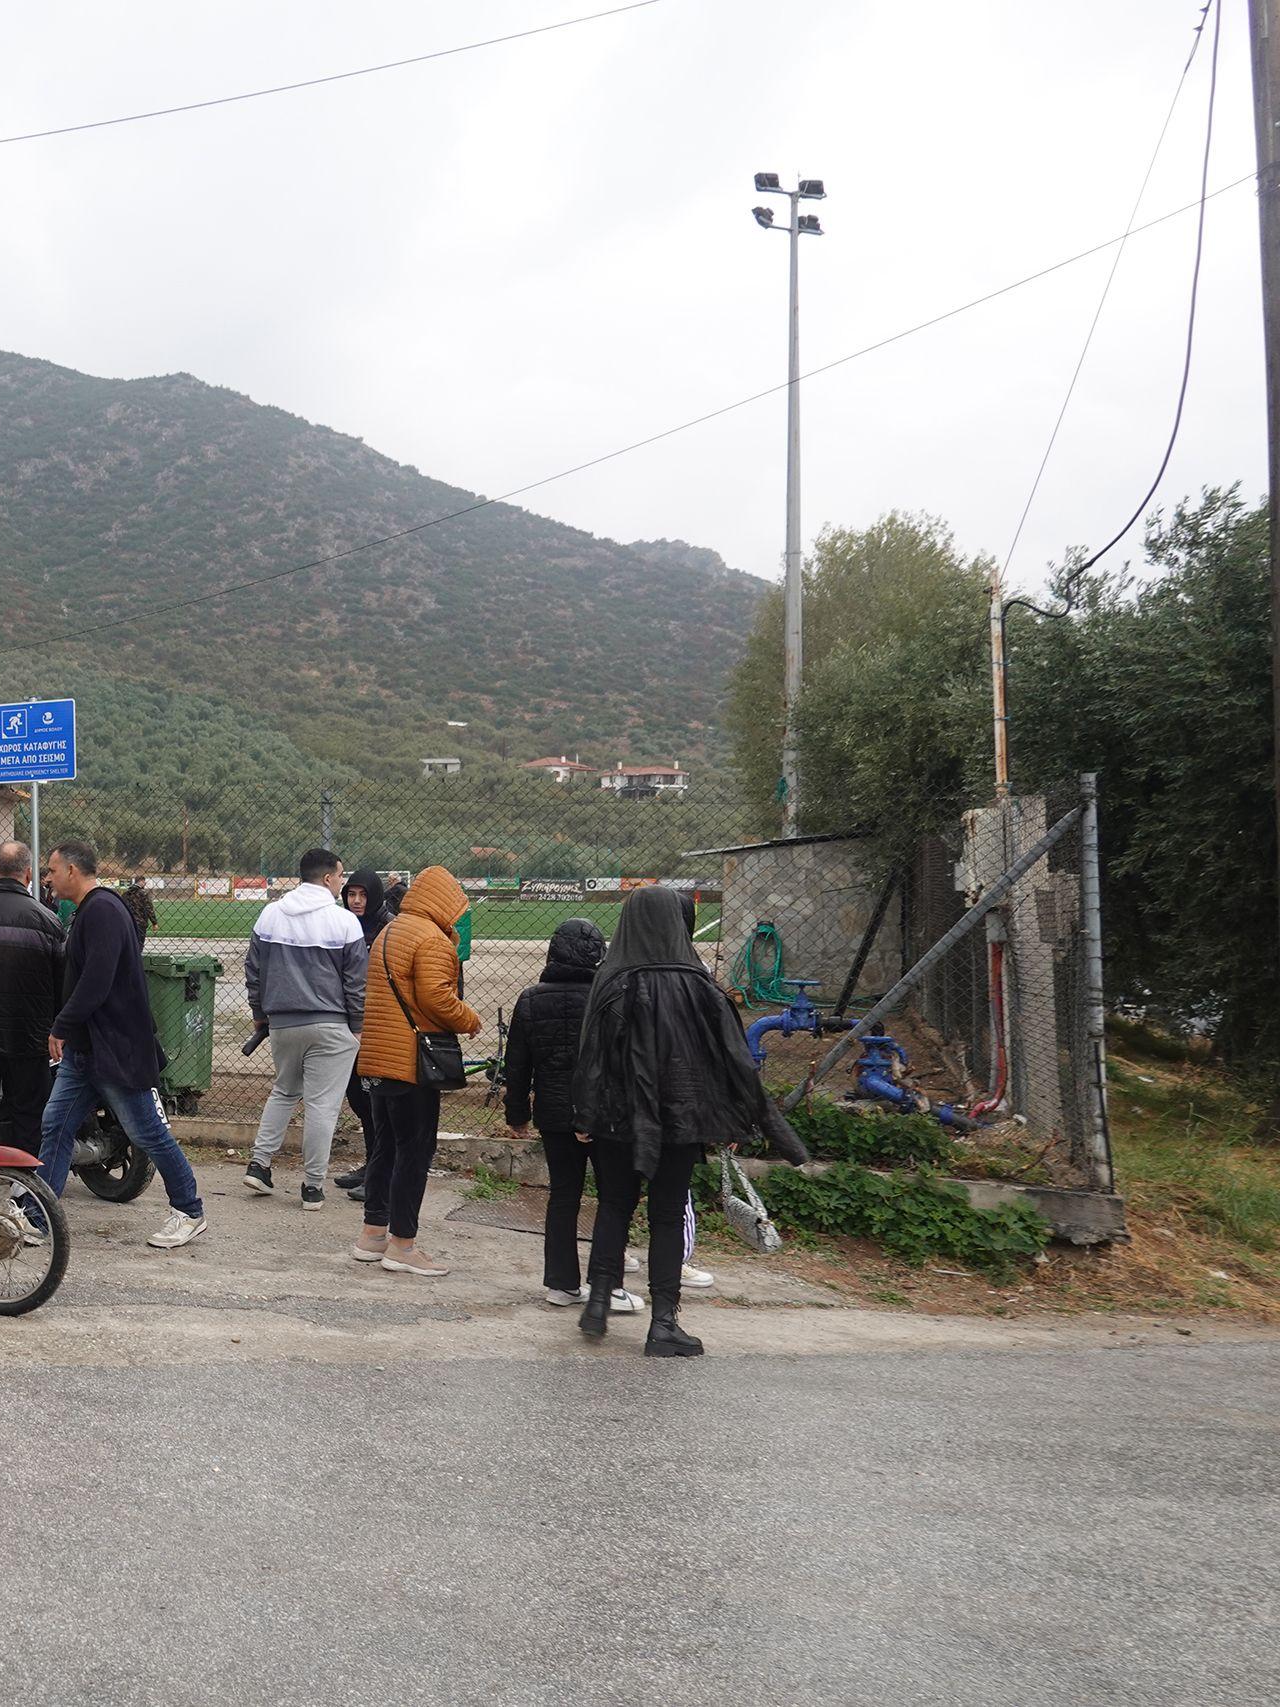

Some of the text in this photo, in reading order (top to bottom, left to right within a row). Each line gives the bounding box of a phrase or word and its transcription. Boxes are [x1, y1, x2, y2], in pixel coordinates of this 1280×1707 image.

[0, 740, 67, 753] ΧΩΡΟΣ ΚΑΤΑΦΥΓΗΣ
[0, 753, 65, 765] ΜΕΤΑ ΑΠΟ ΣΕΙΣΜΟ
